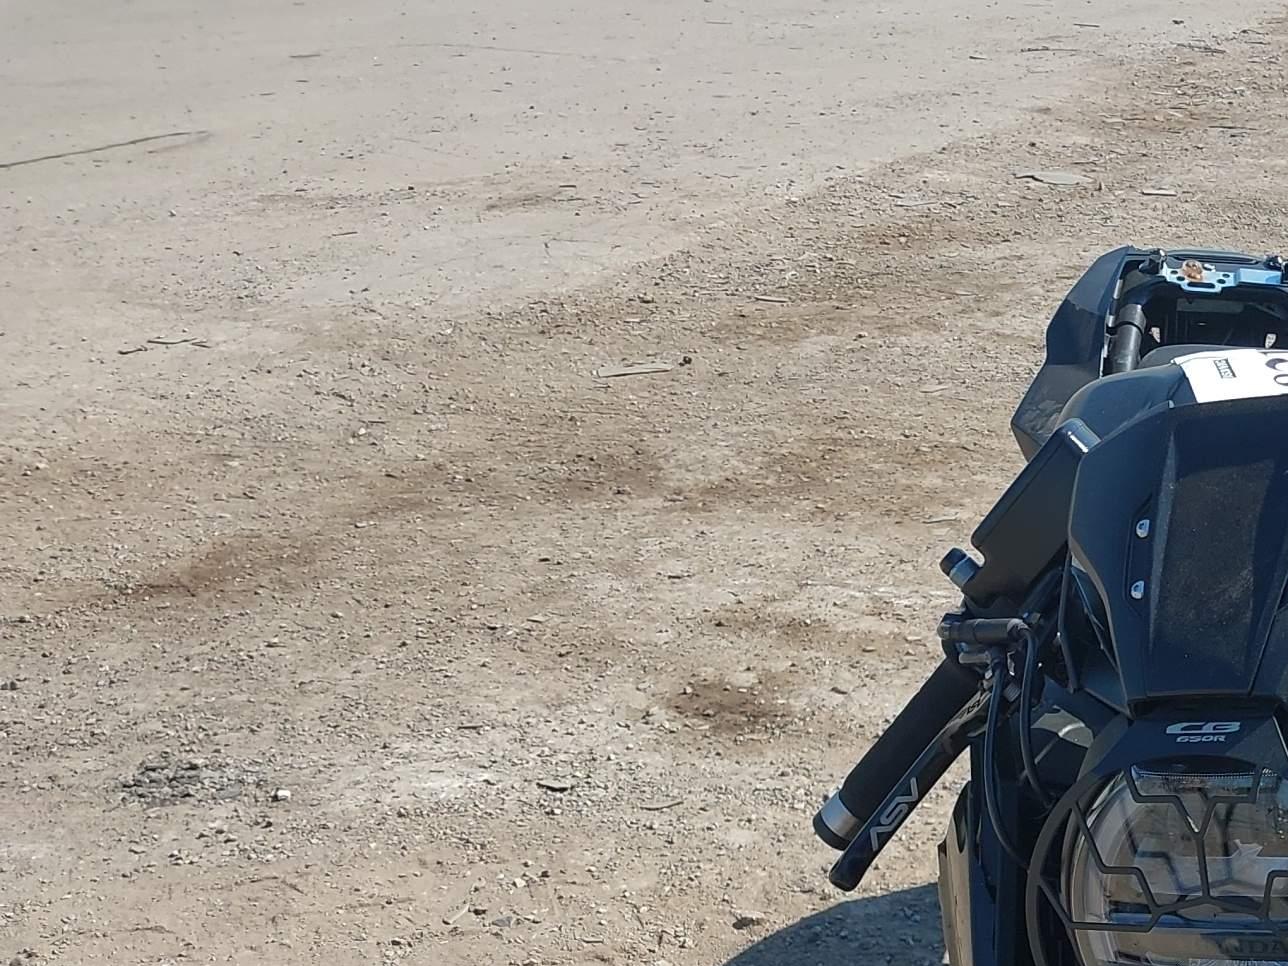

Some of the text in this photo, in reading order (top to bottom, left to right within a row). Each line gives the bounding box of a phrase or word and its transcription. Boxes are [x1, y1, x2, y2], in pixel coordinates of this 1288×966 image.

[1165, 721, 1241, 734] CB
[1175, 735, 1226, 743] 650R
[869, 777, 919, 852] ASV
